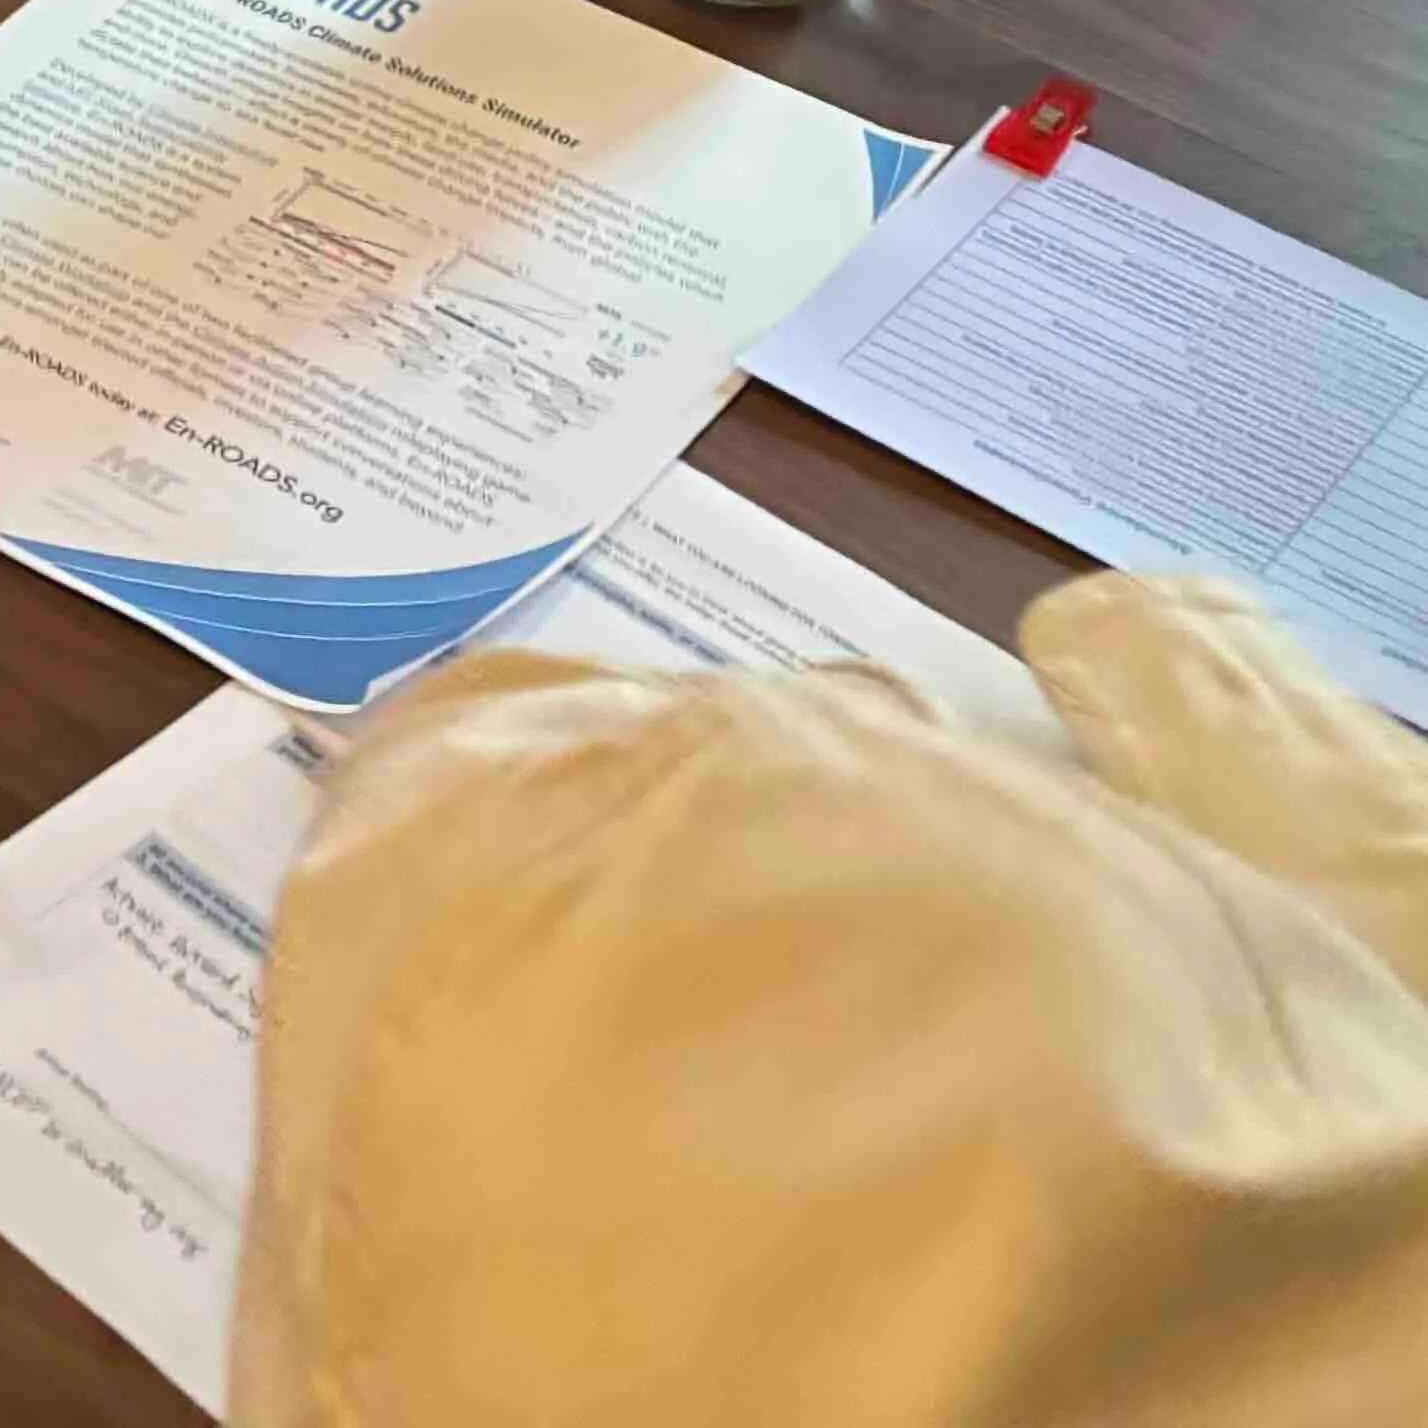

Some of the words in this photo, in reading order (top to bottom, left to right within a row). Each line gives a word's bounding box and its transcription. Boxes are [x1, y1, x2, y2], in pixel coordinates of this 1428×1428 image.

[307, 24, 383, 65] Climate
[384, 56, 479, 105] Solutions
[481, 97, 581, 149] Simulator
[163, 414, 344, 524] En-ROADS.org
